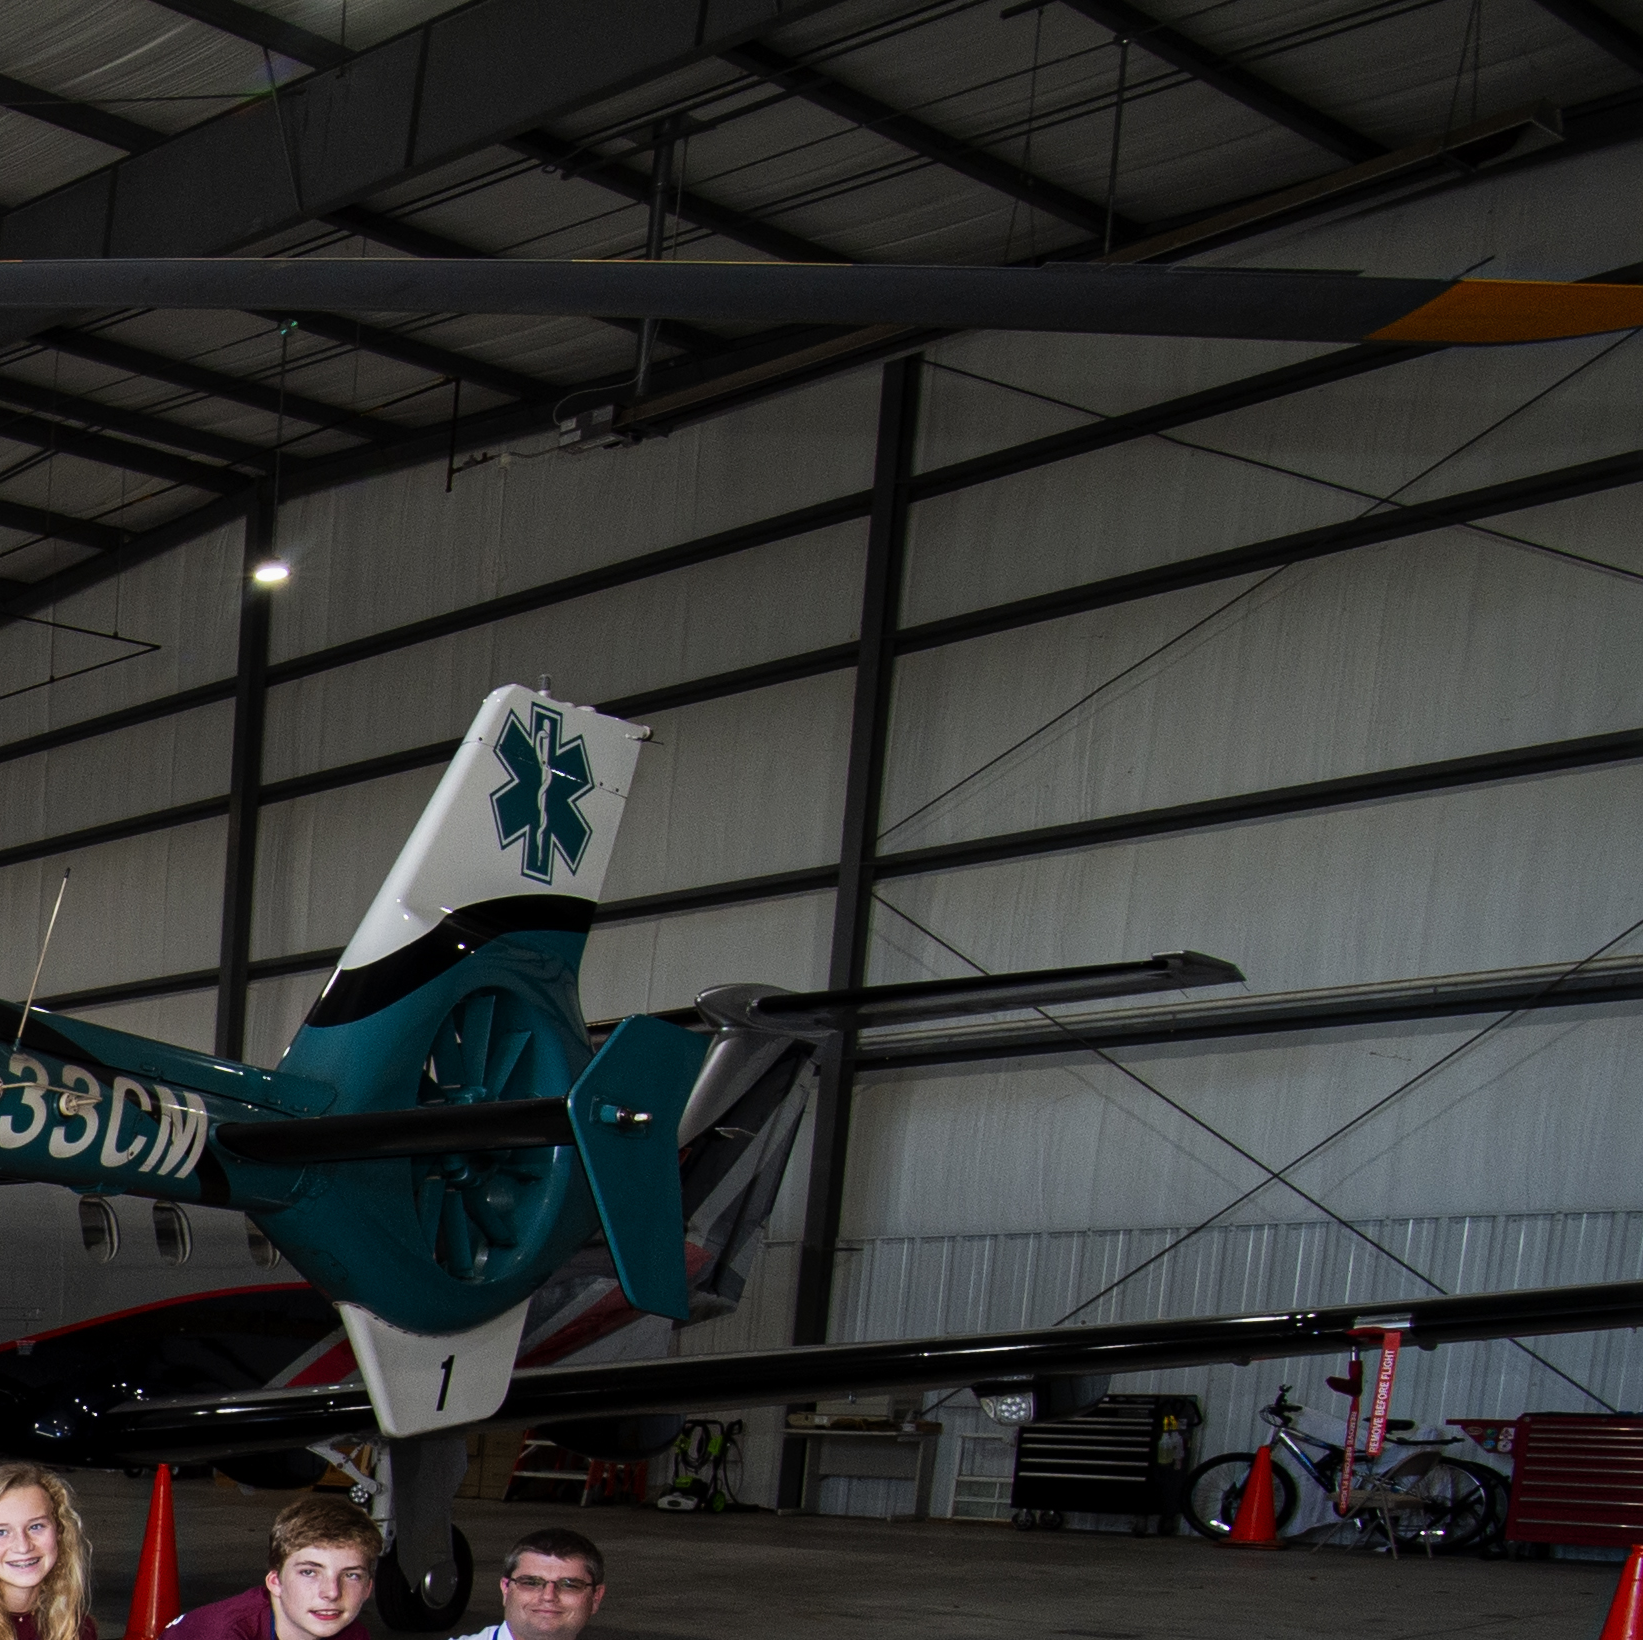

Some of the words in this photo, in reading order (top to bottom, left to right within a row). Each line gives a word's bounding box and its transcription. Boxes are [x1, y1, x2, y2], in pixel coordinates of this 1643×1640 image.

[436, 1353, 456, 1412] 1
[1381, 1349, 1396, 1380] FLIGHT
[1375, 1381, 1390, 1417] BEFORE
[1369, 1416, 1386, 1453] REMOVE
